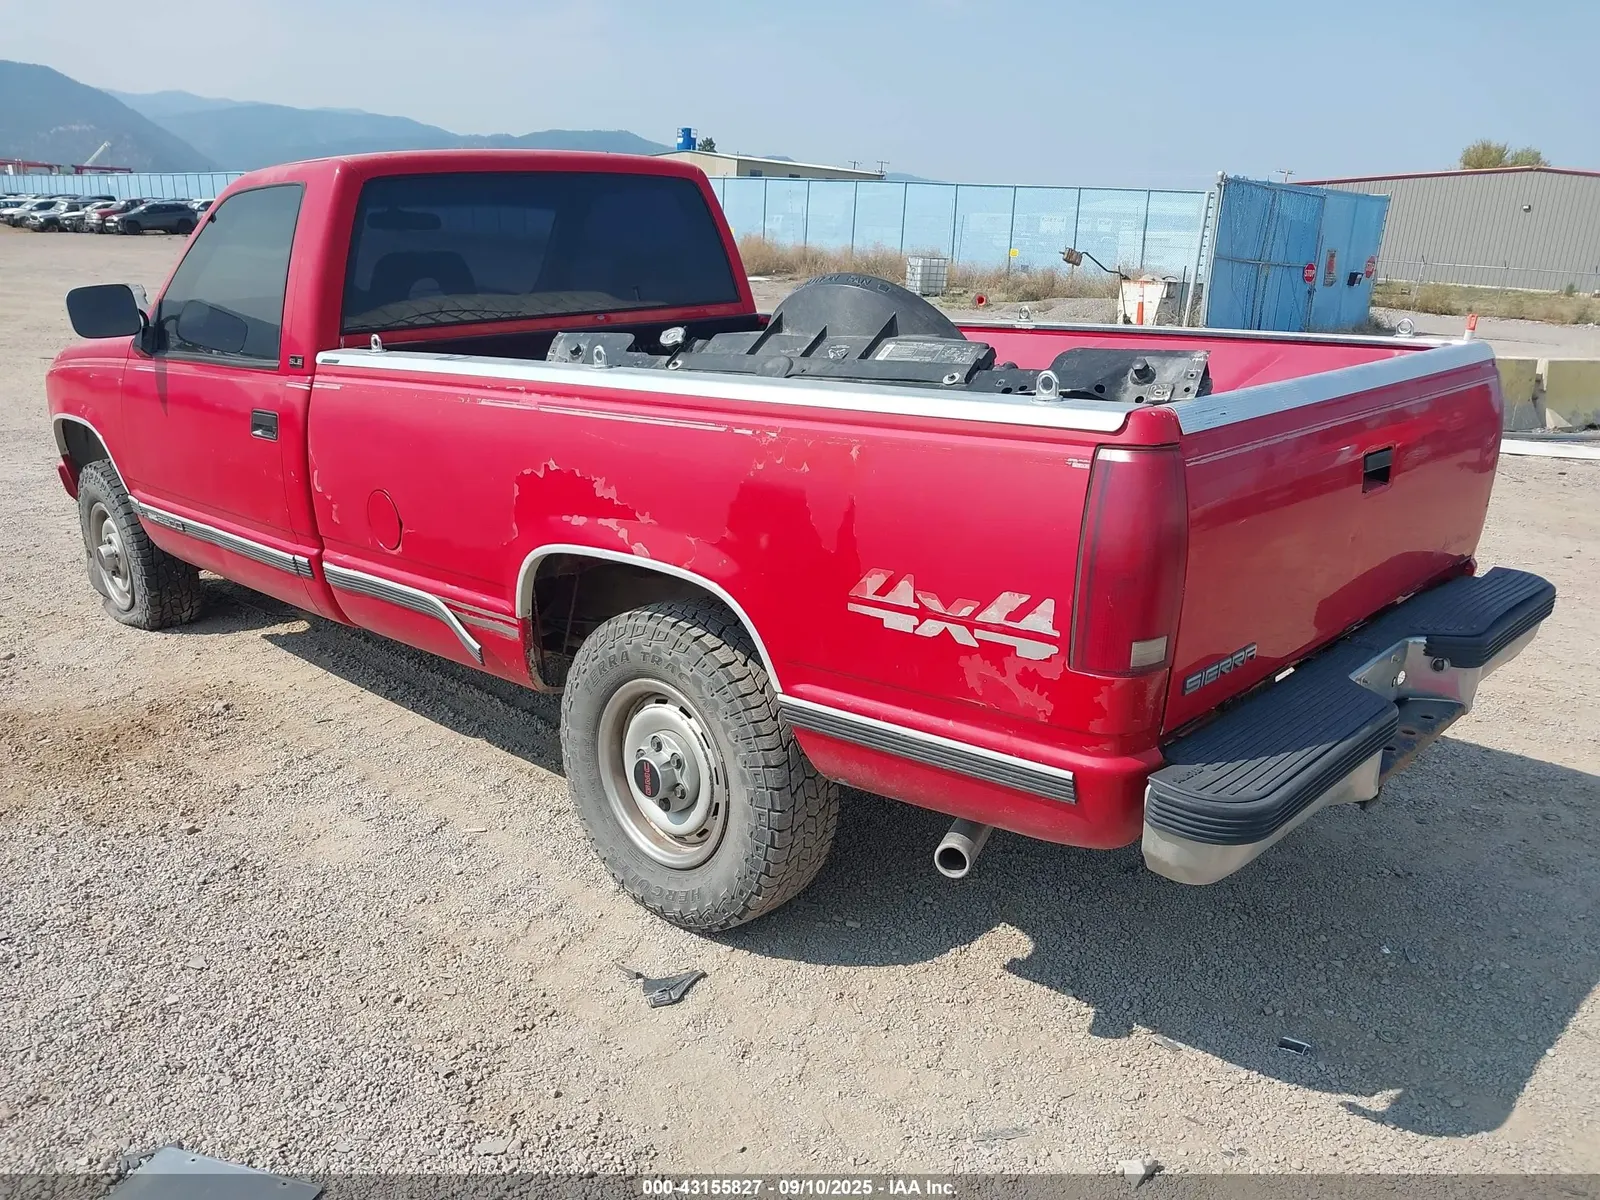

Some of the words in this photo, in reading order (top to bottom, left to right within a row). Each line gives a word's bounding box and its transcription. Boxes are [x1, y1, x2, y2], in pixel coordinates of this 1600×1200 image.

[1304, 269, 1315, 277] STOP
[584, 650, 632, 697] TERRA
[639, 650, 693, 685] TRAC
[1182, 643, 1258, 697] SIERRA
[643, 761, 652, 796] GMC
